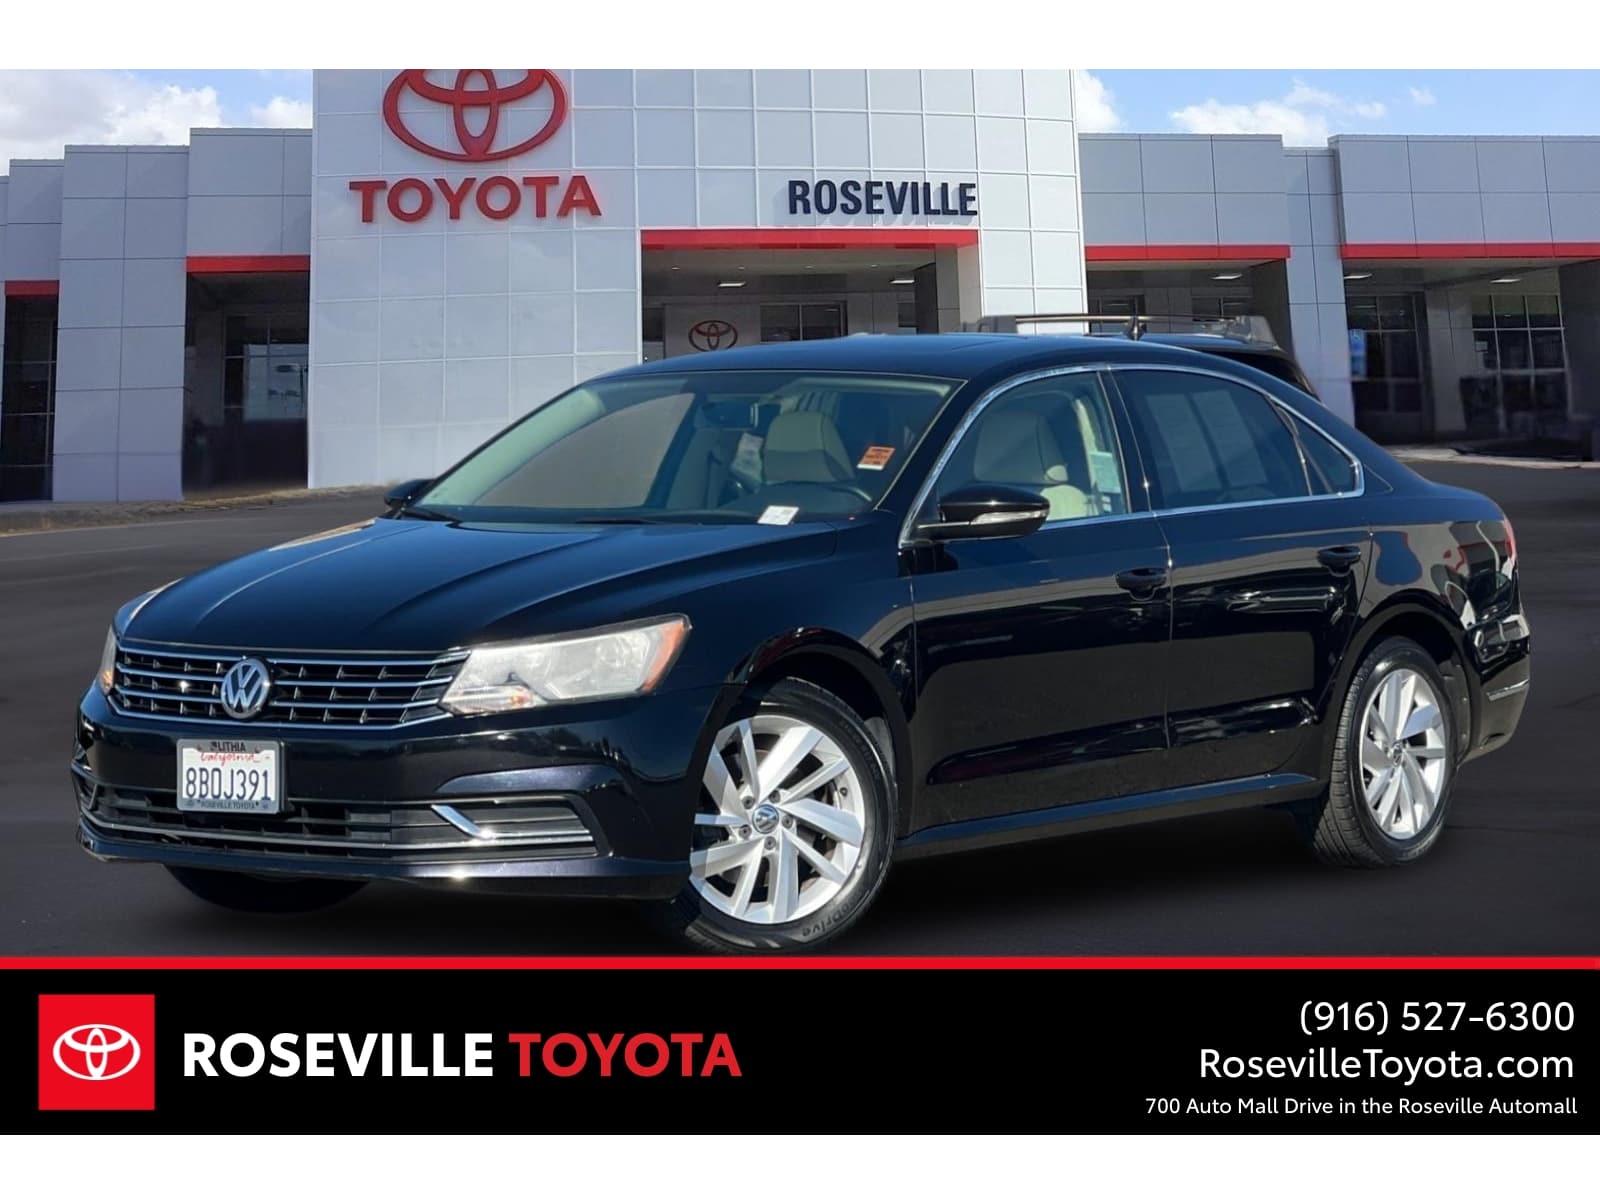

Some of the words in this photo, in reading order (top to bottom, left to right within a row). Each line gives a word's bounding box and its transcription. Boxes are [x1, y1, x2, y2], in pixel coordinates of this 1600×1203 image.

[349, 174, 602, 223] TOYOTA
[787, 179, 978, 216] ROSEVILLE
[217, 742, 246, 752] LITHIA
